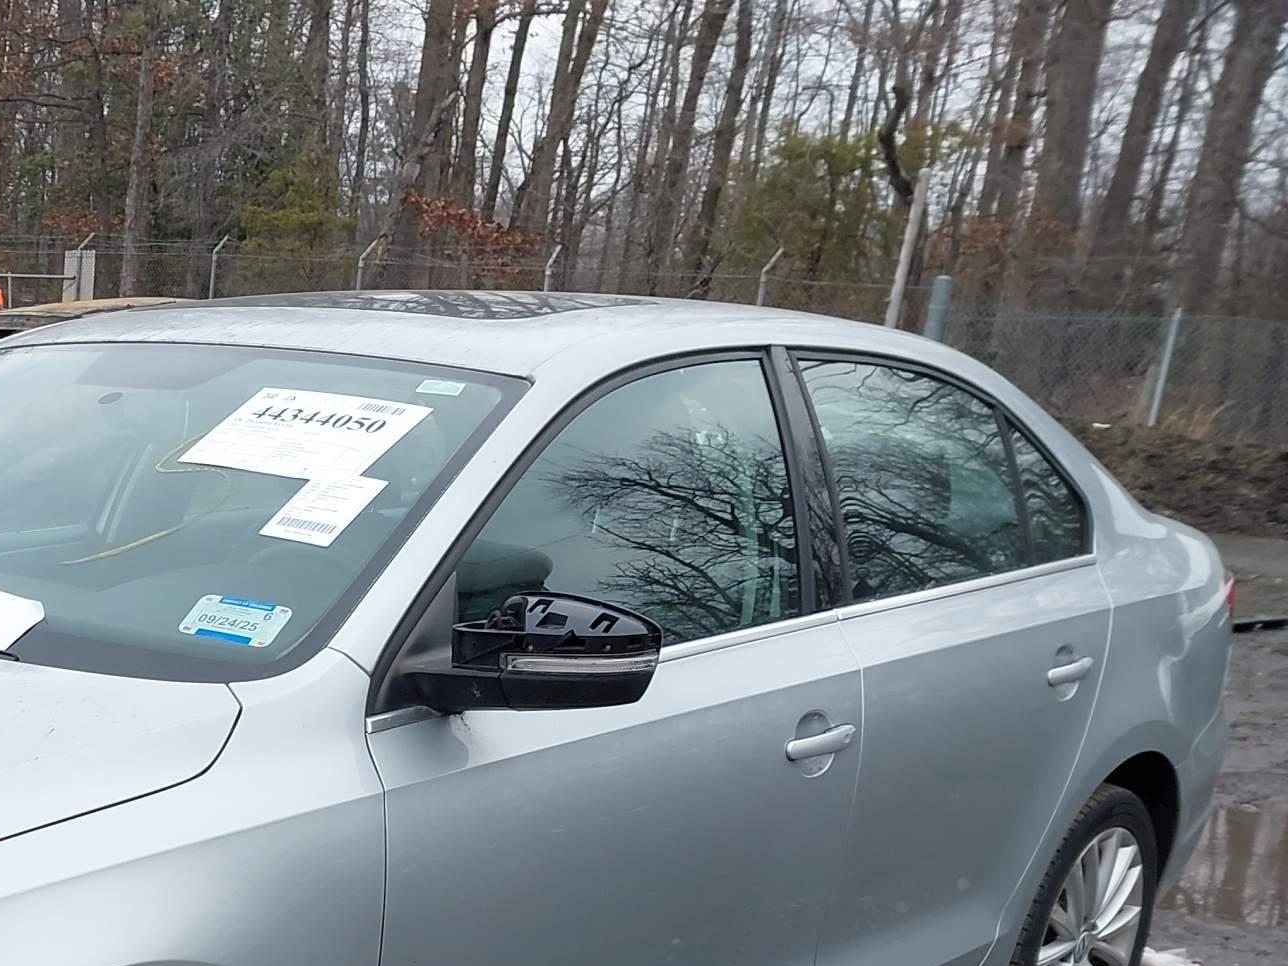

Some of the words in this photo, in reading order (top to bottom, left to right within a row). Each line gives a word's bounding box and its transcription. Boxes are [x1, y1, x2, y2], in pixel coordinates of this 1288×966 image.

[252, 406, 387, 434] 44344050
[198, 613, 259, 632] 09/24/25
[263, 612, 274, 621] 6
